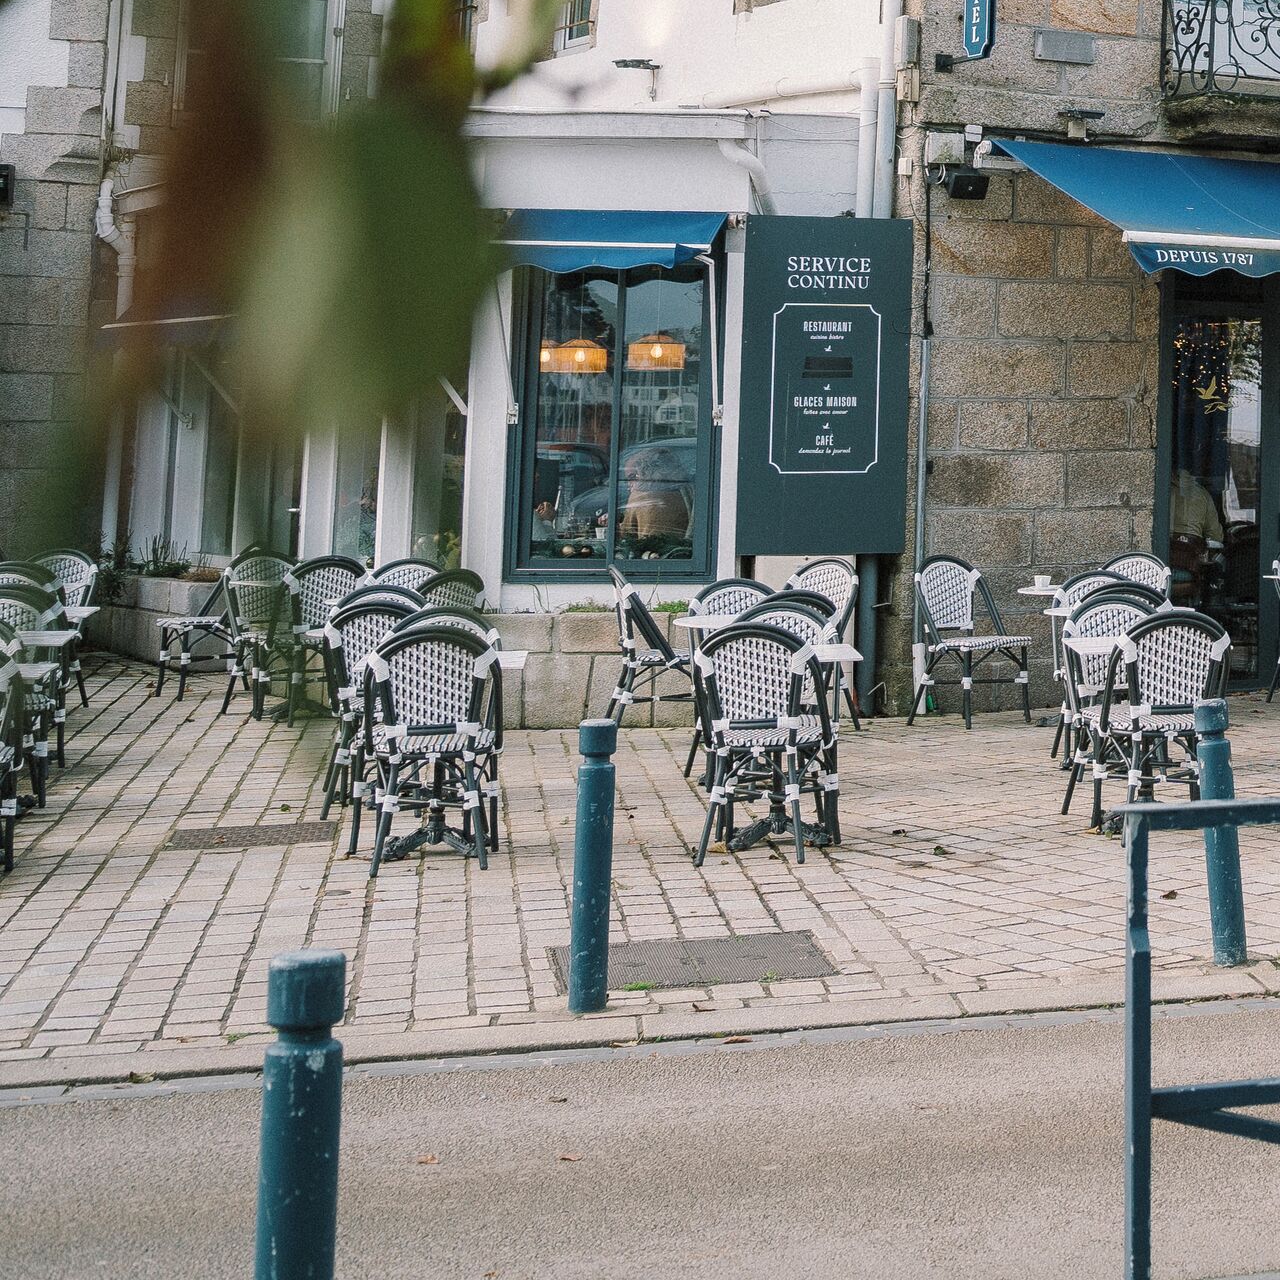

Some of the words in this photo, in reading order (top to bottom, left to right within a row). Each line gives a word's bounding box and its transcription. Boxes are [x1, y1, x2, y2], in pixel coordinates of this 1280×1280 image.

[787, 256, 871, 273] SERVICE
[1155, 249, 1219, 264] DEPUIS
[1221, 252, 1254, 266] 1787
[787, 274, 870, 290] CONTINU
[803, 321, 853, 332] RESTAURANT
[793, 396, 823, 408] GLACES
[826, 396, 857, 408] MAISON
[815, 433, 834, 446] CAFÉ
